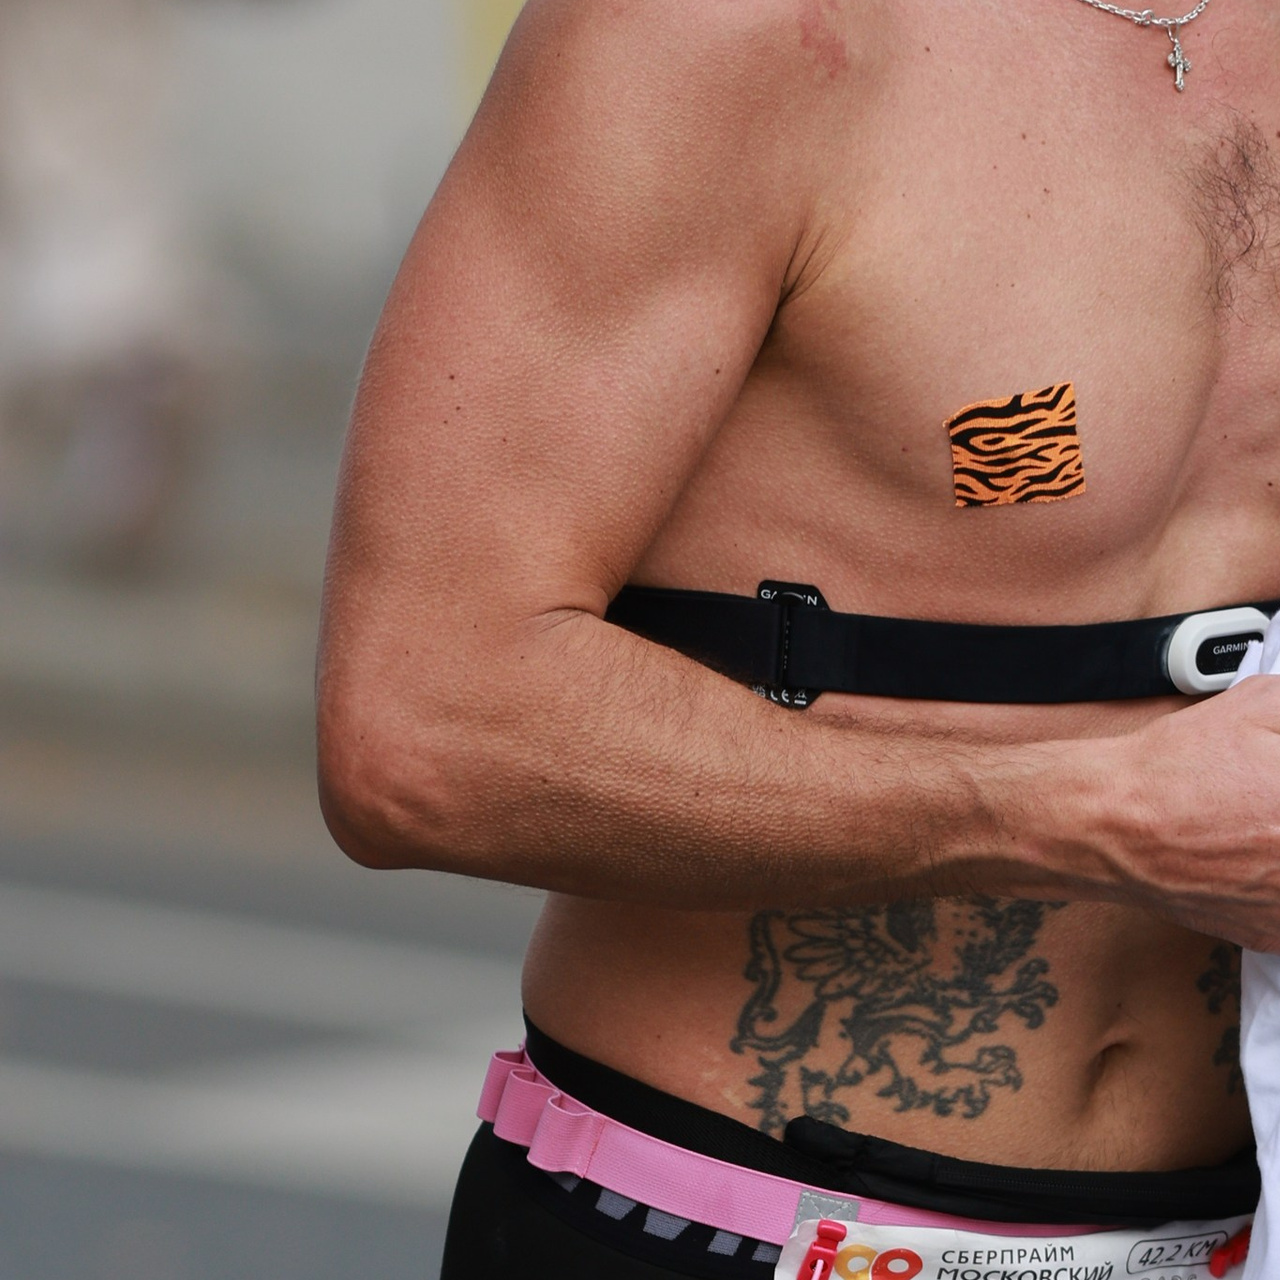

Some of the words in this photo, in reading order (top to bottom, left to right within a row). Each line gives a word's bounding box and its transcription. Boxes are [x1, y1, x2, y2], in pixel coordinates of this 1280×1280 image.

[1213, 642, 1249, 655] GARMIN
[942, 1244, 1074, 1265] СБЕРПРАЙМ
[1138, 1244, 1182, 1266] 42,2
[1183, 1238, 1218, 1259] КМ
